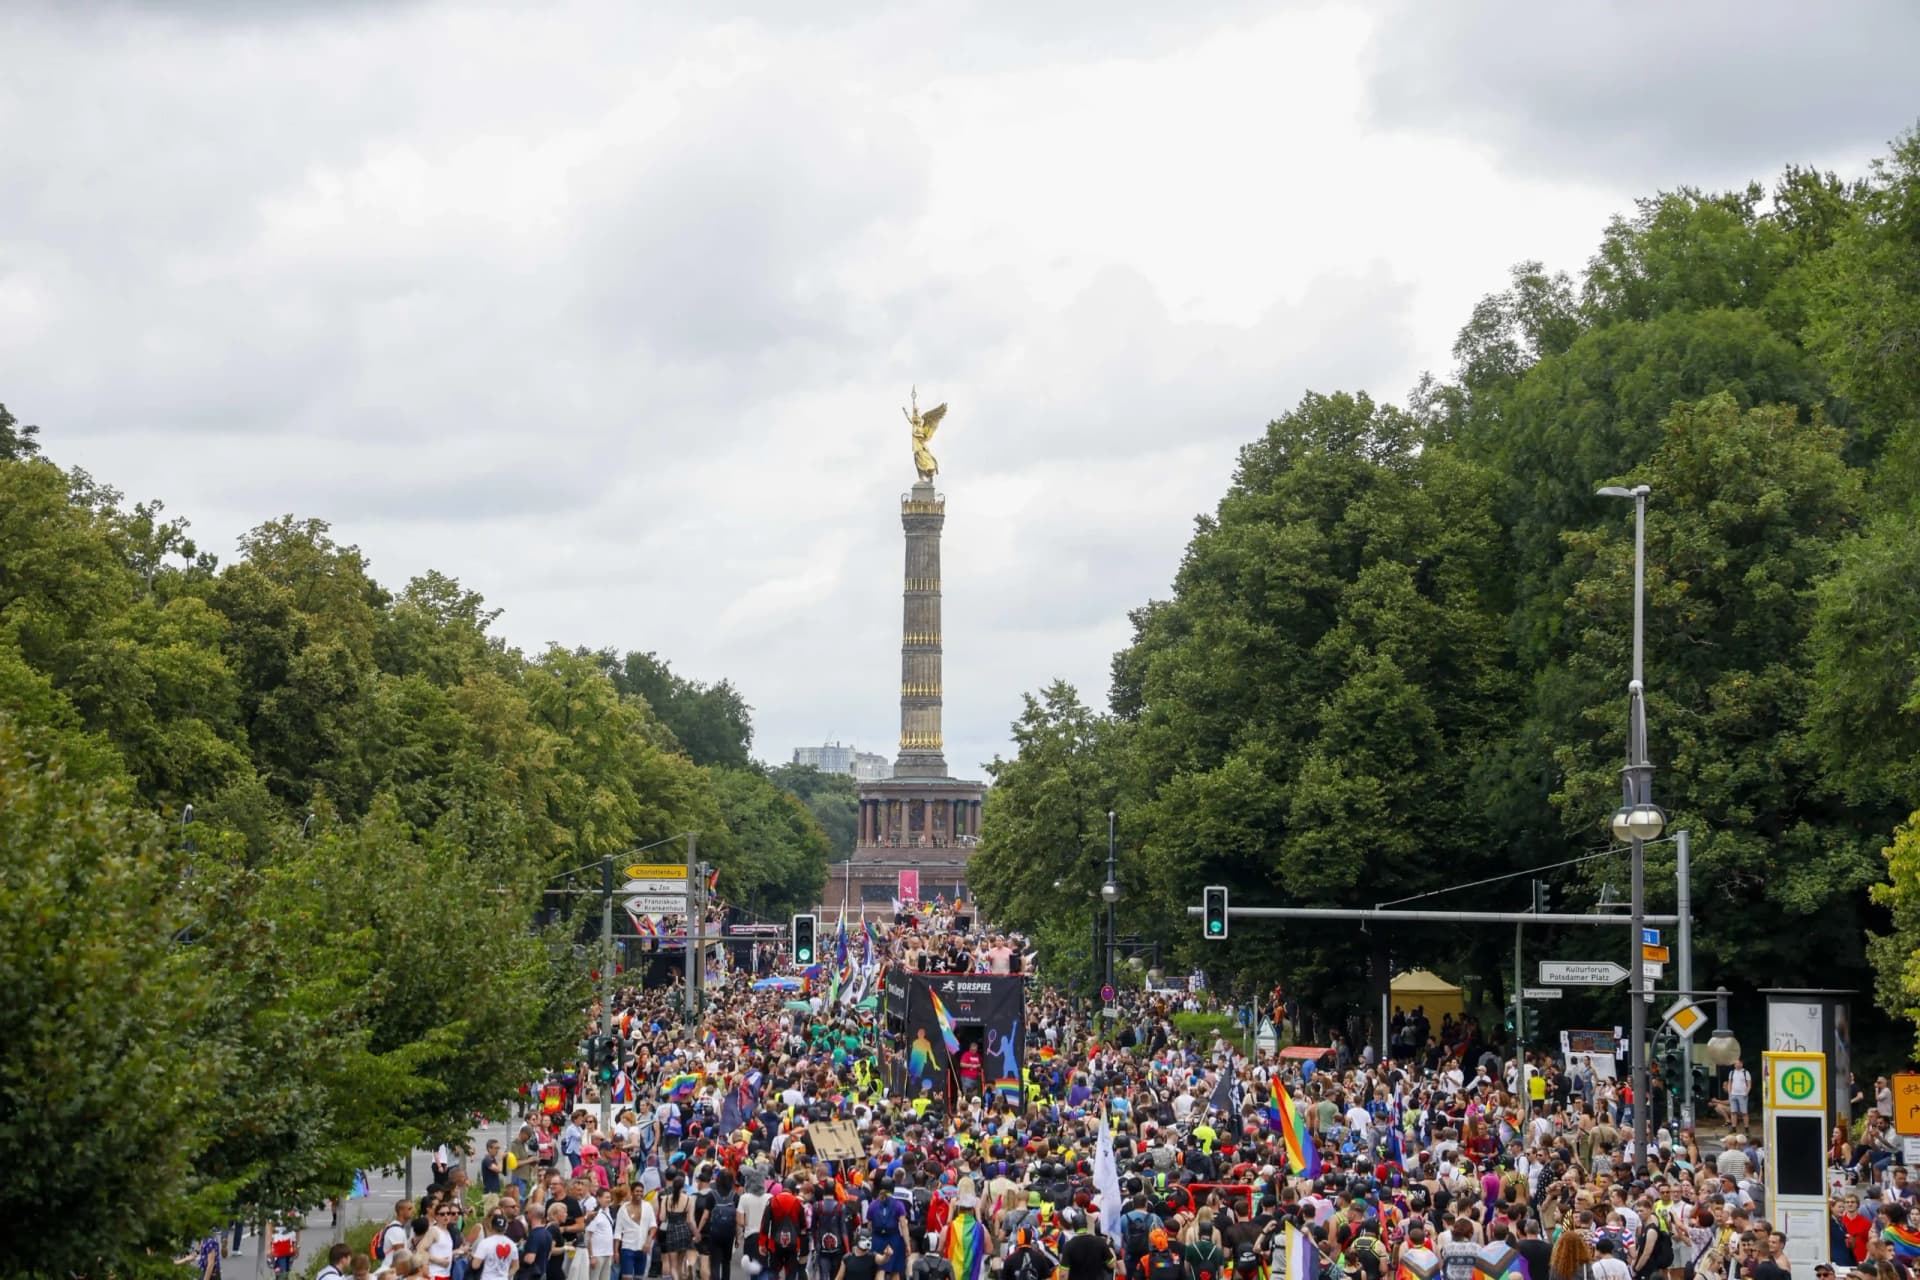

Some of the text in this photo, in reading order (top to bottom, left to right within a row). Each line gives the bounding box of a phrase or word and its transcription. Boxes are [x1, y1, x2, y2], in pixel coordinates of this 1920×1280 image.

[1549, 973, 1610, 981] Potsdamer Platz
[957, 982, 992, 991] VORSPIEL
[1791, 1074, 1805, 1093] H
